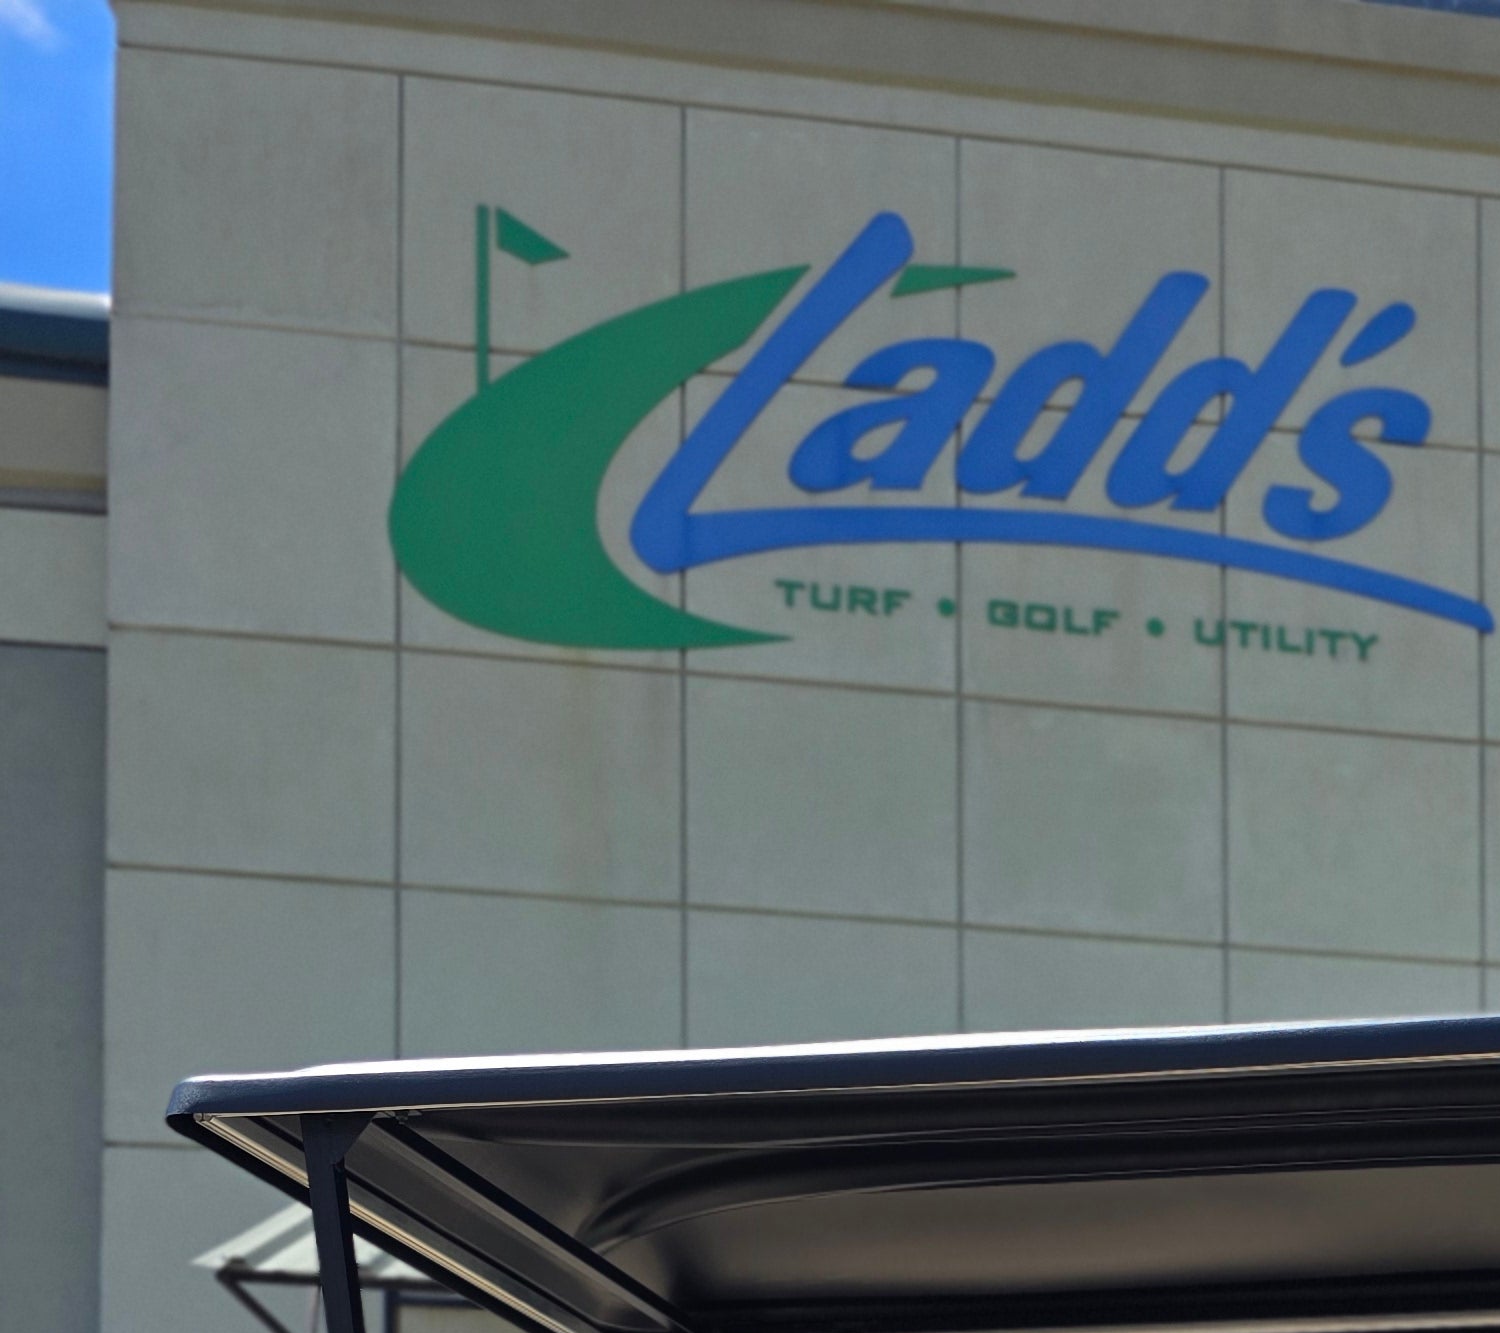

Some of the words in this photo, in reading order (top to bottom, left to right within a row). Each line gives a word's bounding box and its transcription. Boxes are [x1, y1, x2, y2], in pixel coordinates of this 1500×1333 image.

[629, 211, 1494, 634] Ladd's
[774, 578, 911, 617] TURF
[986, 598, 1121, 637] GOLF
[1192, 617, 1380, 662] UTILITY
